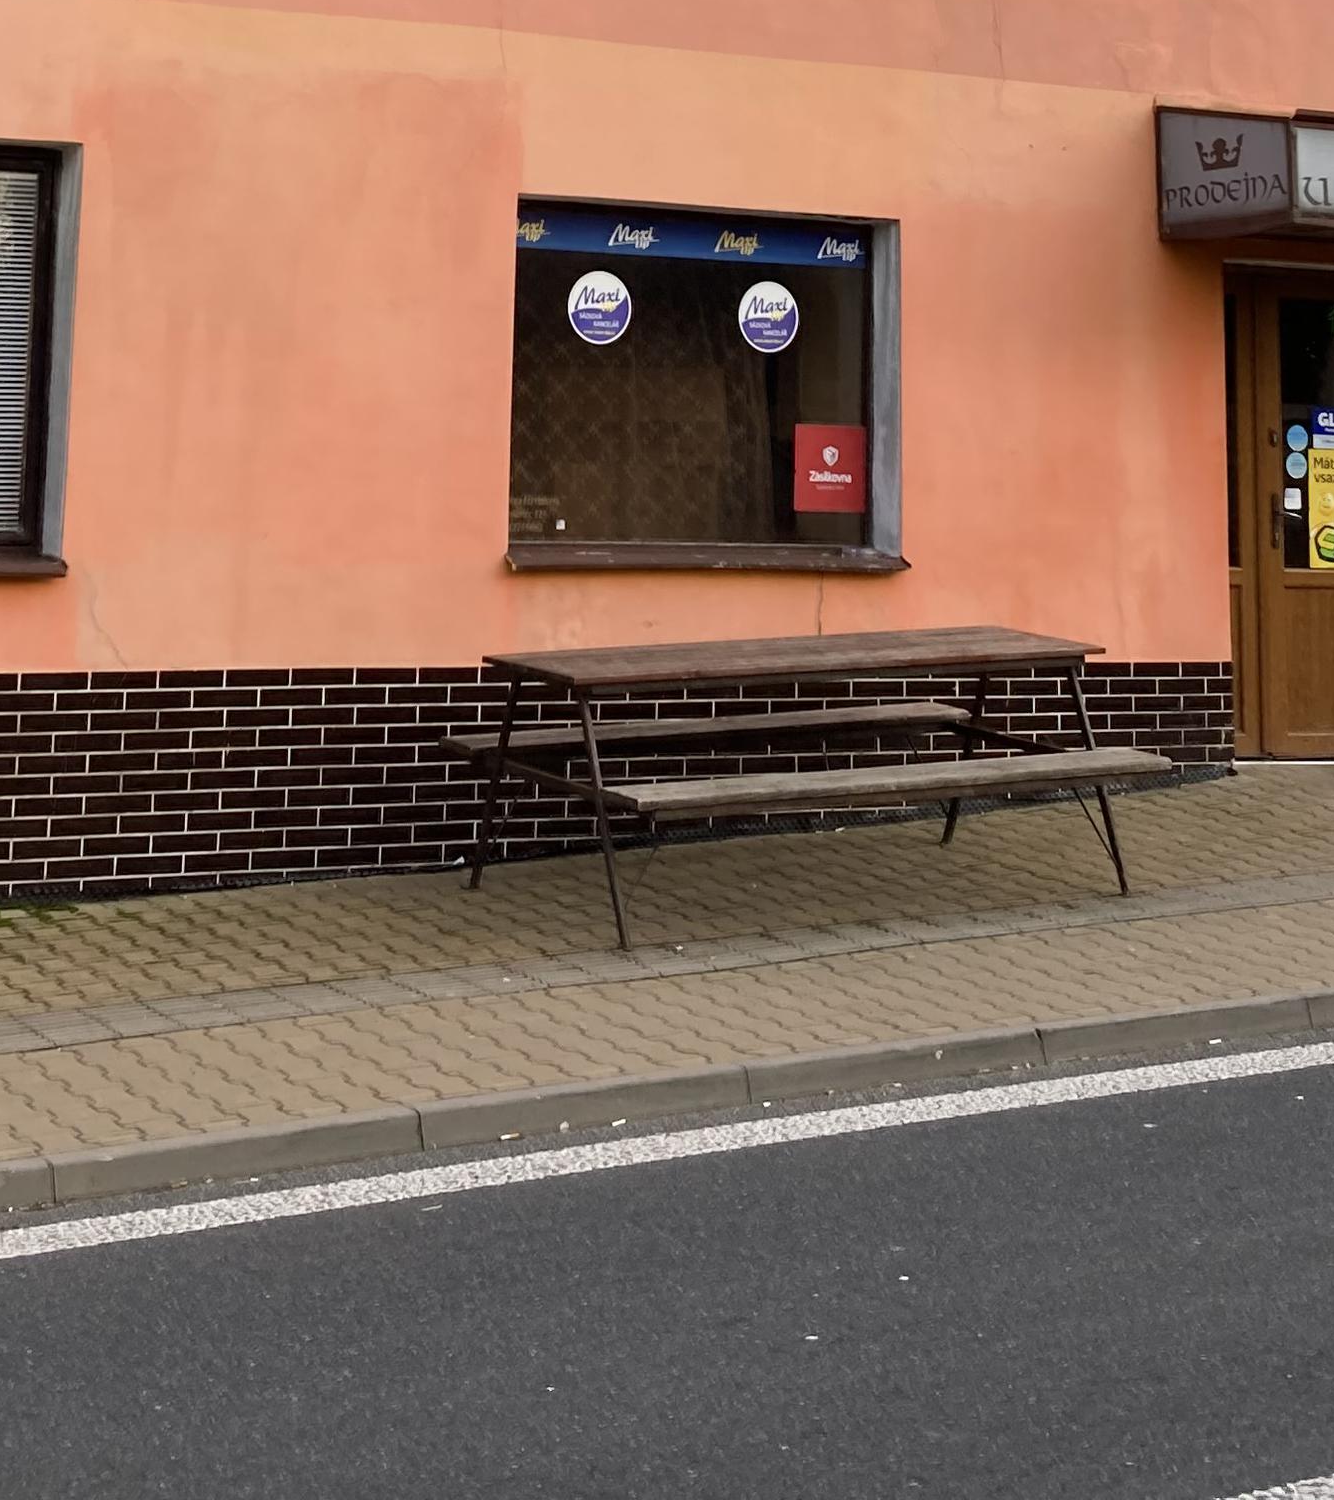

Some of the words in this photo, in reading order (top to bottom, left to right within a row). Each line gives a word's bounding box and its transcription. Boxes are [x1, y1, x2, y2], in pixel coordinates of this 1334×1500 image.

[1302, 176, 1331, 206] U
[608, 223, 654, 246] Maxi
[714, 230, 759, 252] Maxi
[818, 237, 860, 259] Maxi
[574, 285, 621, 310] Maxi
[745, 296, 788, 319] Maxi
